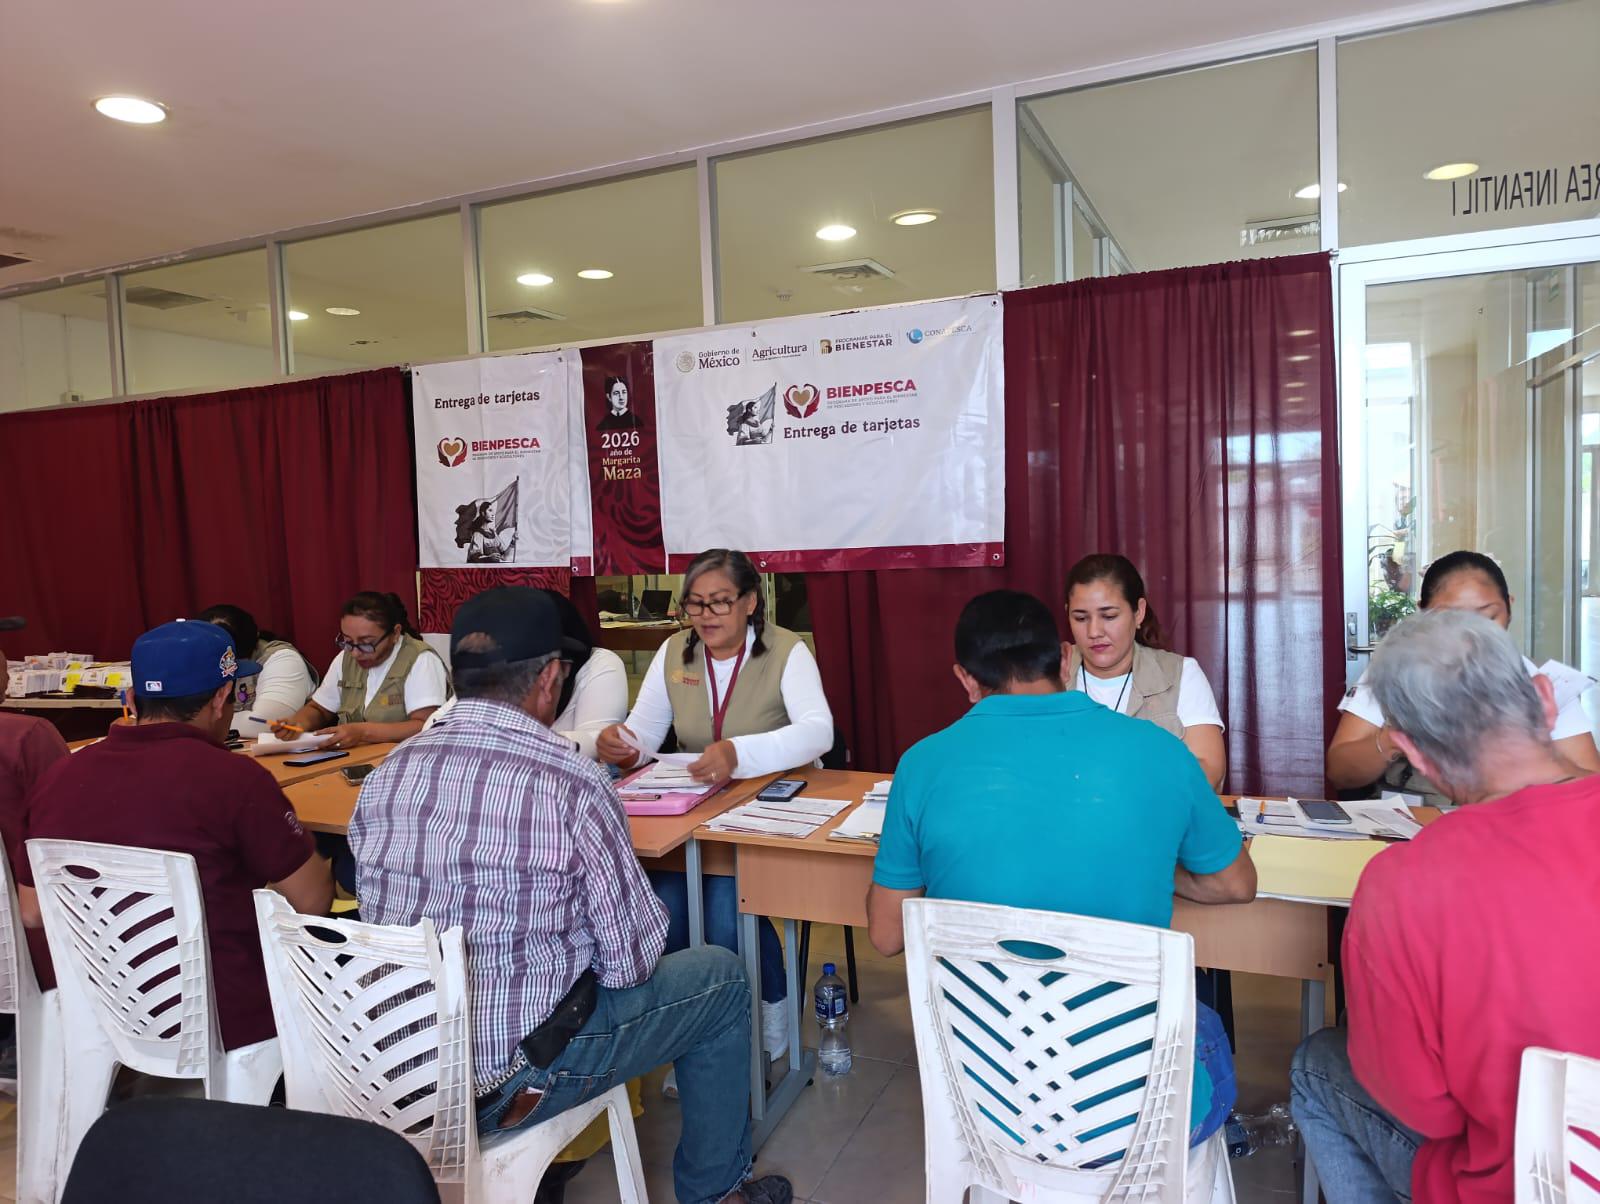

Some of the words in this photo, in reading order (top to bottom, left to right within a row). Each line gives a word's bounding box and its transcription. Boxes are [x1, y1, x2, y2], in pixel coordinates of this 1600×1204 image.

[752, 344, 808, 359] Agricultura
[835, 338, 893, 351] BIENESTAR
[698, 349, 729, 358] Gobierno
[731, 347, 740, 355] de
[698, 355, 740, 369] México
[826, 379, 917, 399] BIENPESCA
[434, 397, 476, 410] Entrega
[477, 393, 490, 405] de
[494, 390, 541, 405] tarjetas
[784, 425, 836, 440] Entrega
[841, 421, 857, 434] de
[863, 417, 920, 434] tarjetas
[471, 437, 541, 452] BIENPESCA
[601, 430, 640, 449] 2026
[609, 448, 623, 456] año
[624, 447, 633, 456] de
[602, 456, 641, 467] Margarita
[603, 465, 642, 481] Maza
